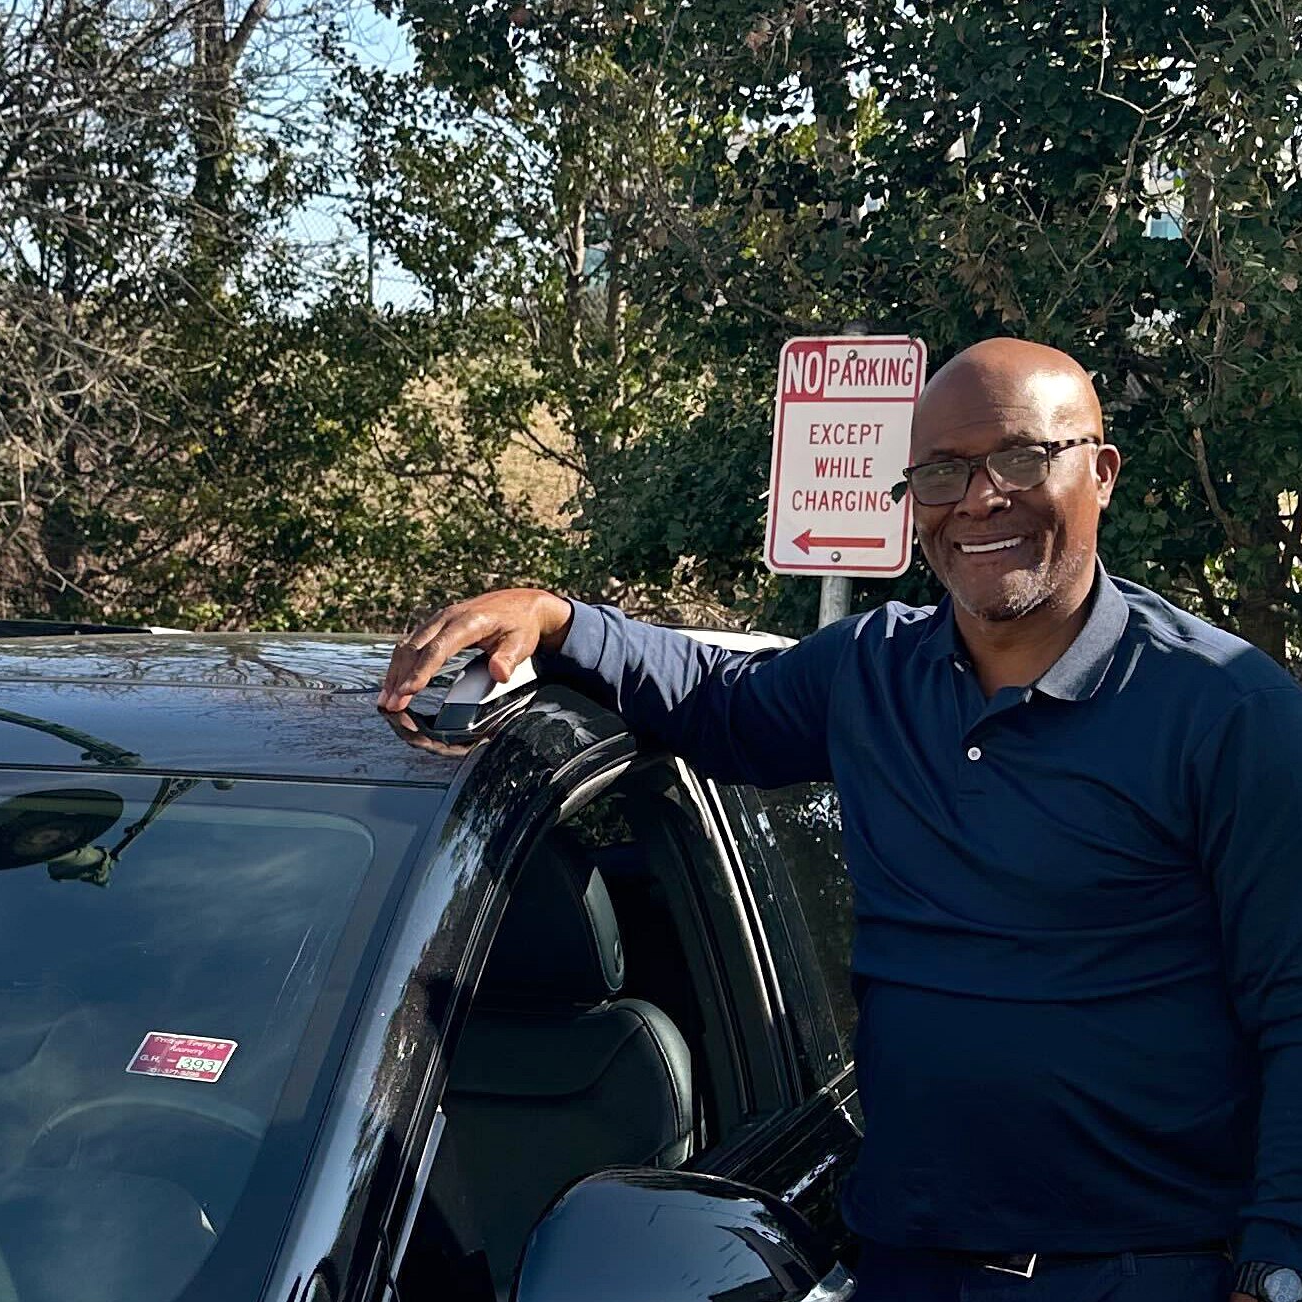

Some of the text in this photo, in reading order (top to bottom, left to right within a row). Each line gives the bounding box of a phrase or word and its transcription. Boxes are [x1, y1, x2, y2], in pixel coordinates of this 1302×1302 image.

[783, 350, 915, 395] NO PARKING
[808, 422, 885, 446] EXCEPT
[814, 456, 875, 479] WHILE
[791, 489, 893, 513] CHARGING
[180, 1057, 216, 1072] 393
